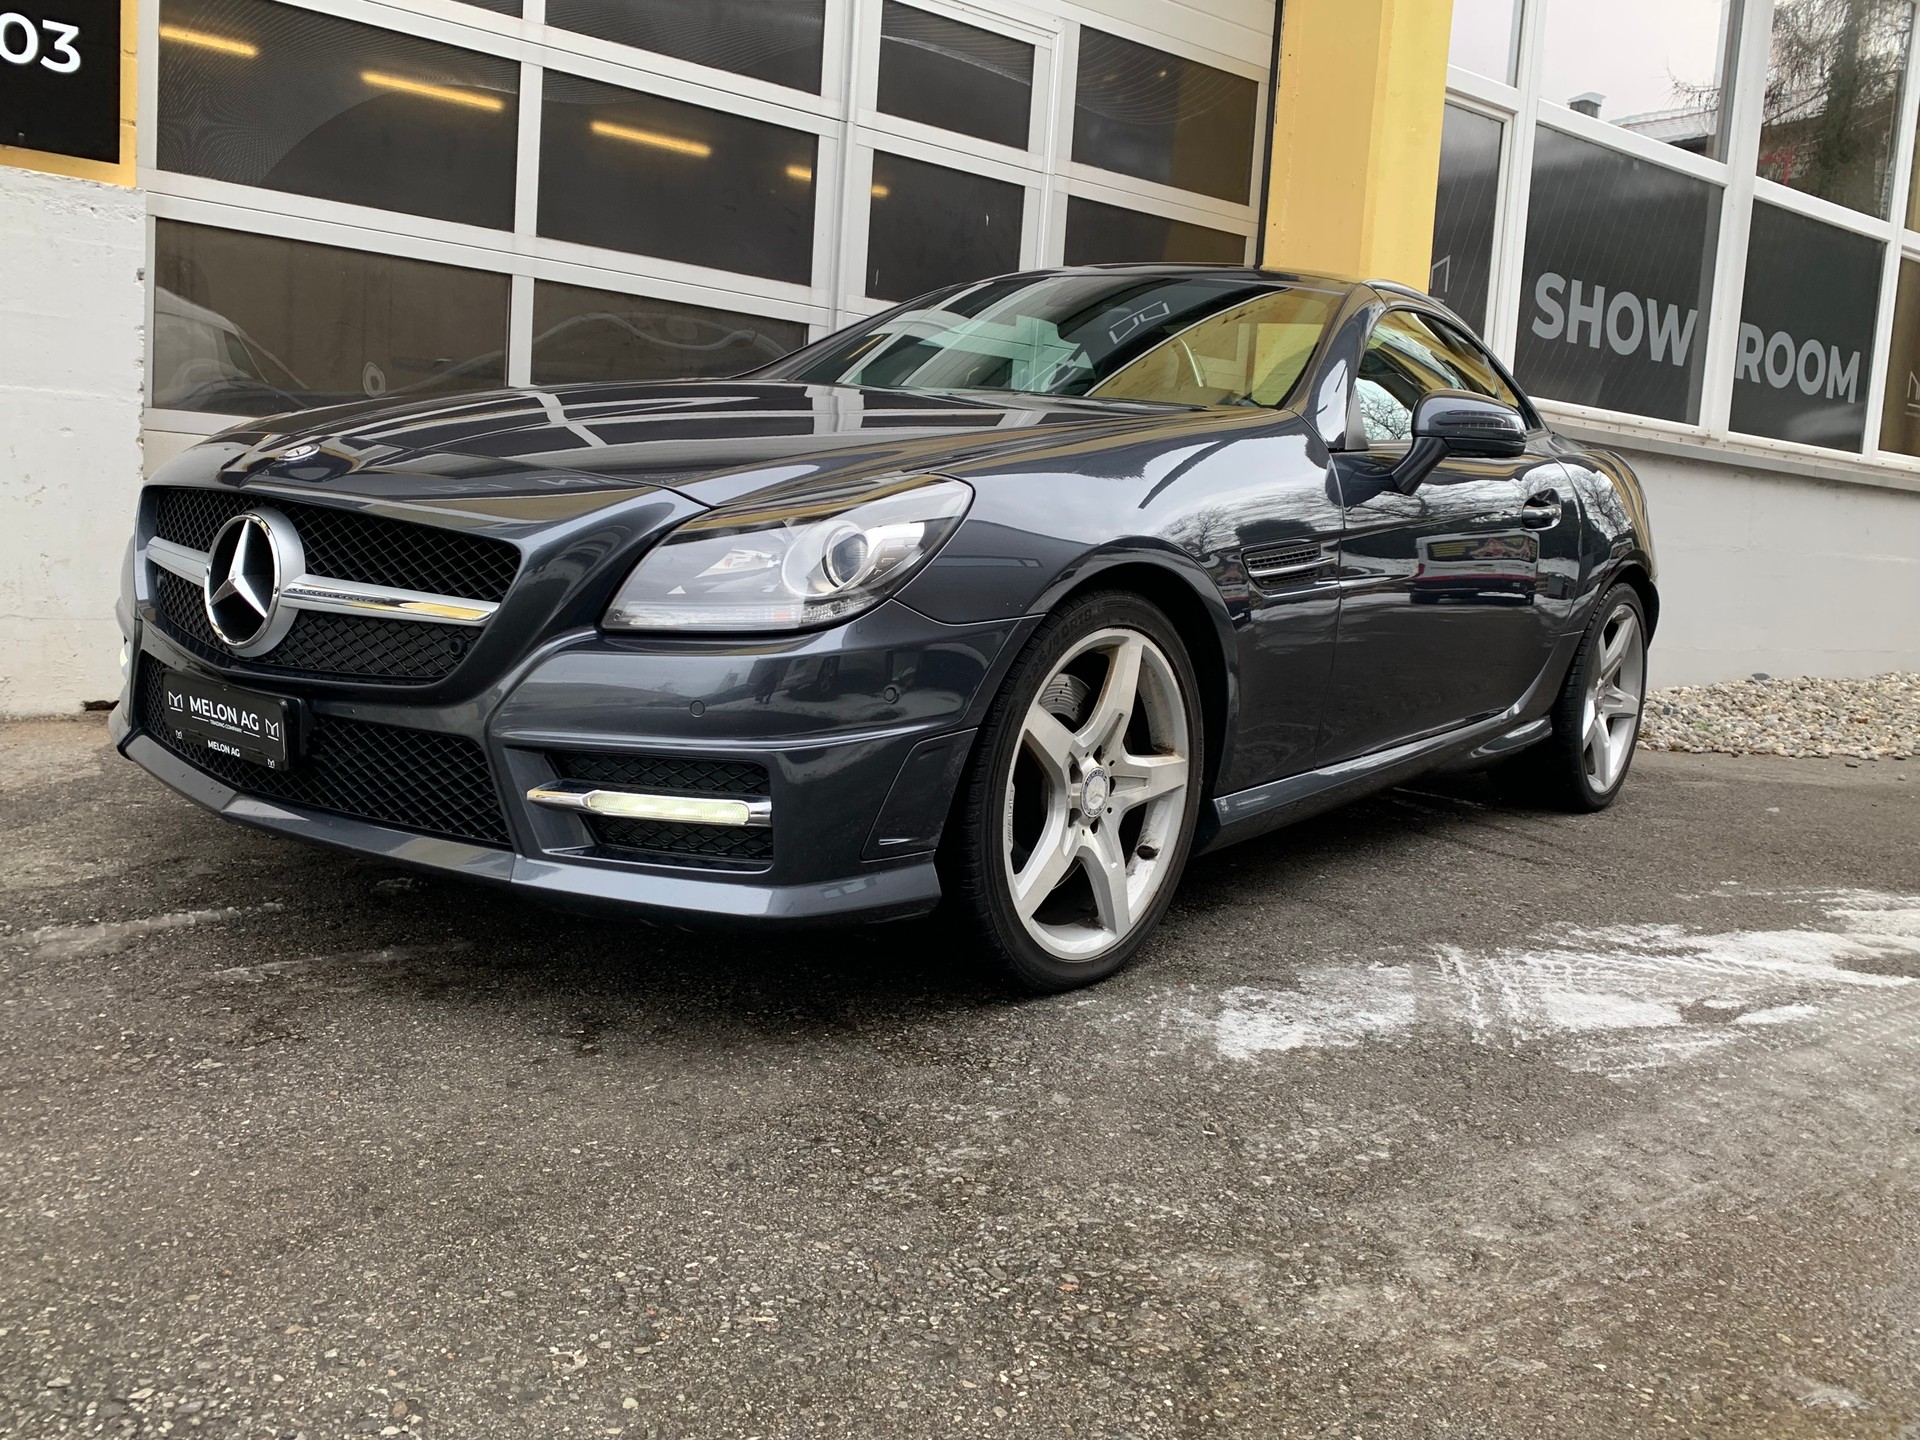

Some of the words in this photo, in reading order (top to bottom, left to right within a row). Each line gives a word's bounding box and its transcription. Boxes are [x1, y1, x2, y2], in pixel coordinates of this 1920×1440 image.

[0, 12, 82, 73] 03
[1531, 272, 1698, 367] SHOW
[1735, 322, 1861, 404] ROOM
[189, 695, 237, 724] MELON
[240, 710, 260, 731] AG
[207, 739, 230, 754] MELON
[230, 746, 240, 758] AG
